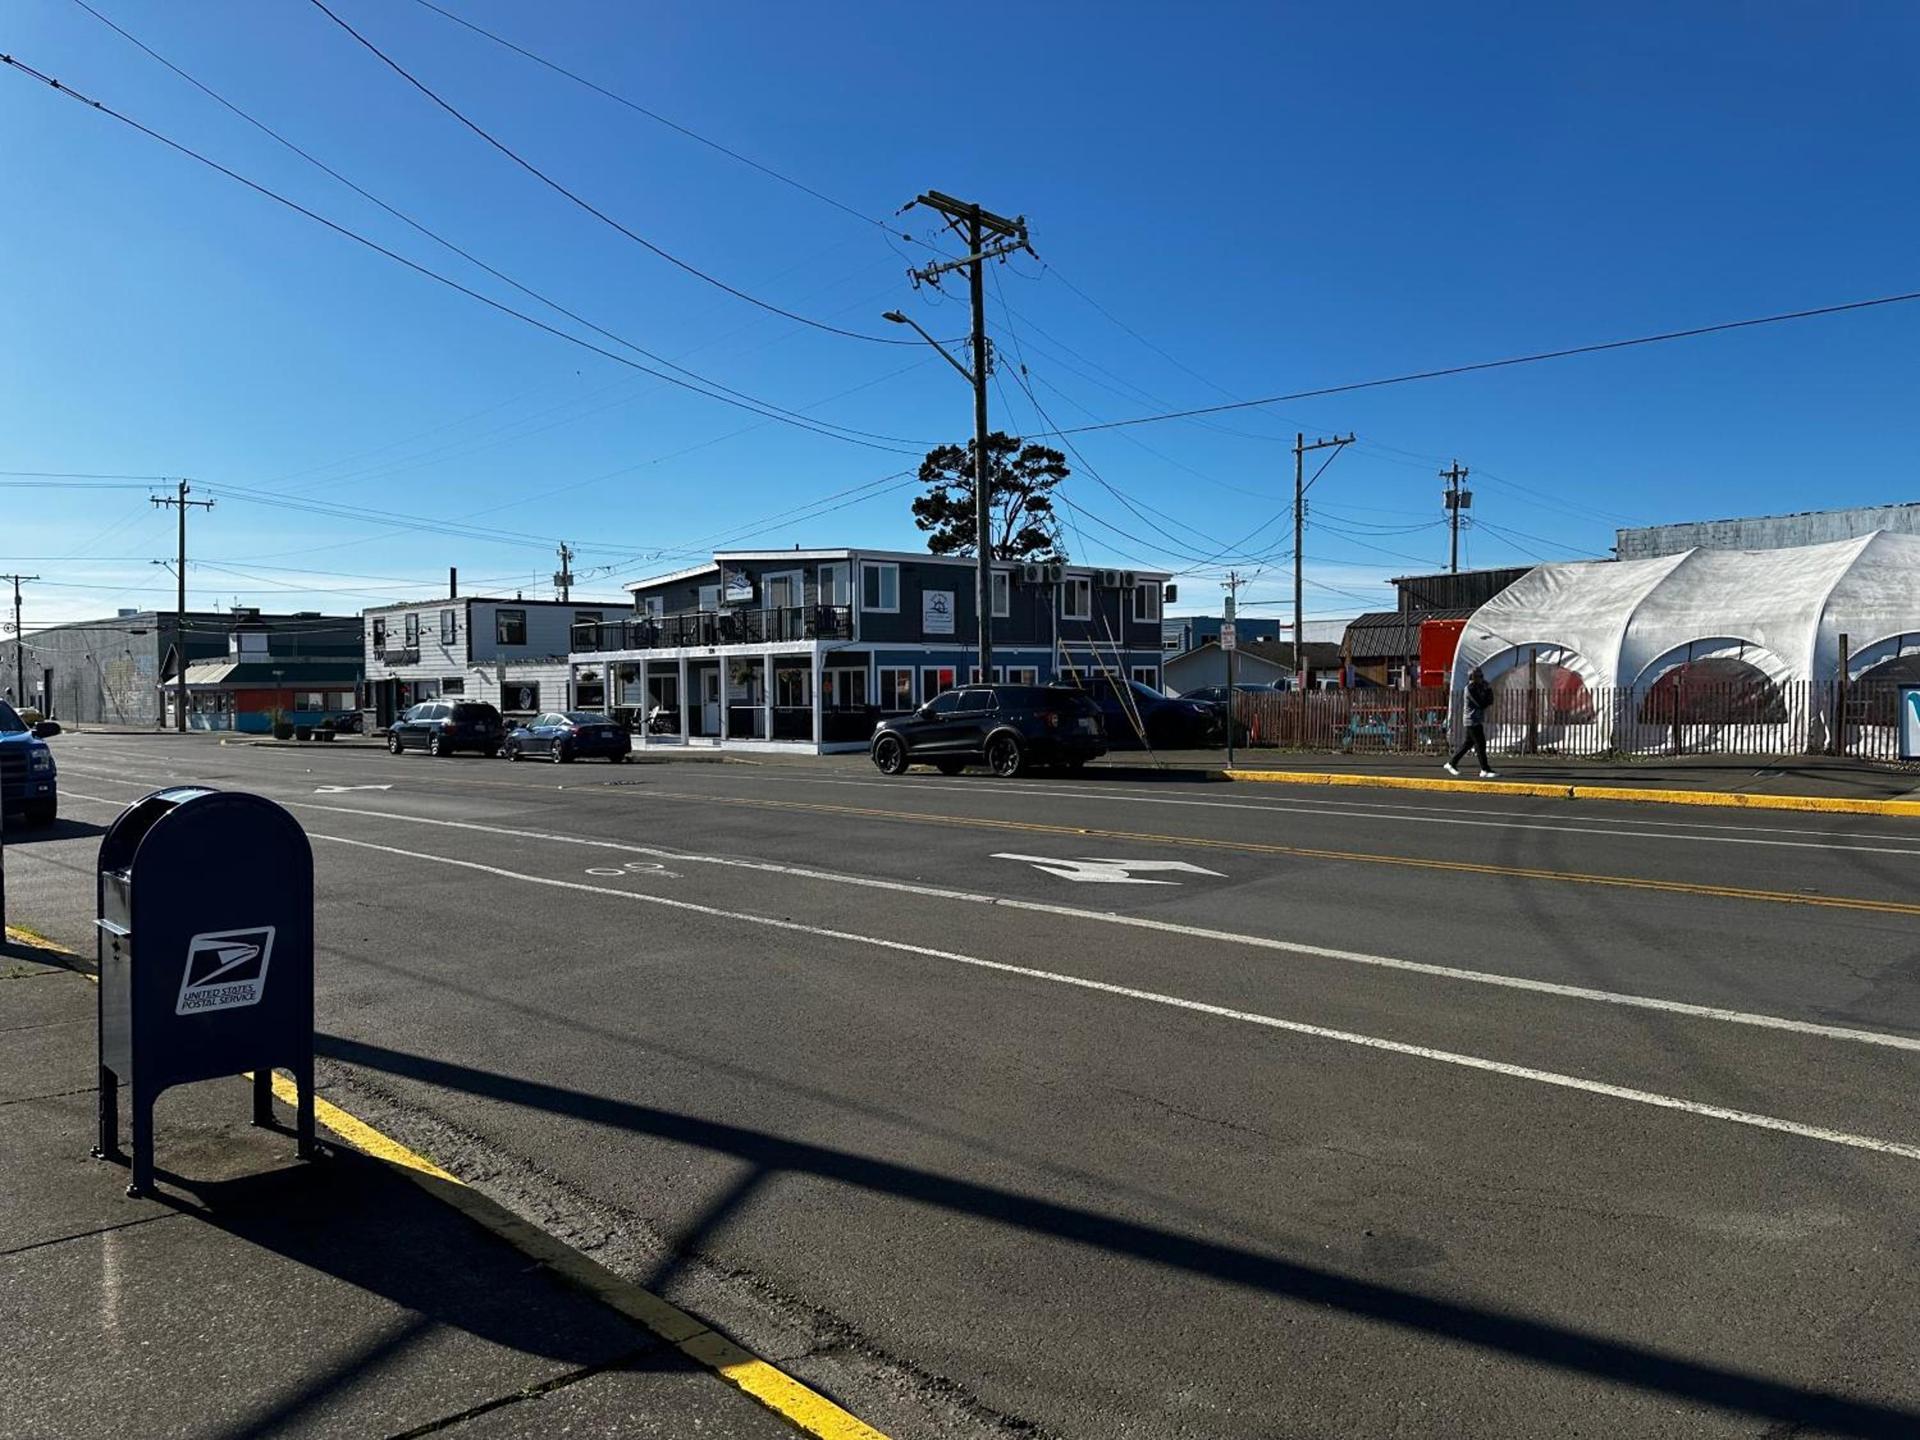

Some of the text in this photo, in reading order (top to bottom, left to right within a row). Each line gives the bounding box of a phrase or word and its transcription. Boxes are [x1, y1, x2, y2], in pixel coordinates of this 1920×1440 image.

[184, 984, 256, 1000] UNITED STATES
[182, 993, 255, 1010] POSTAL SERVICE
